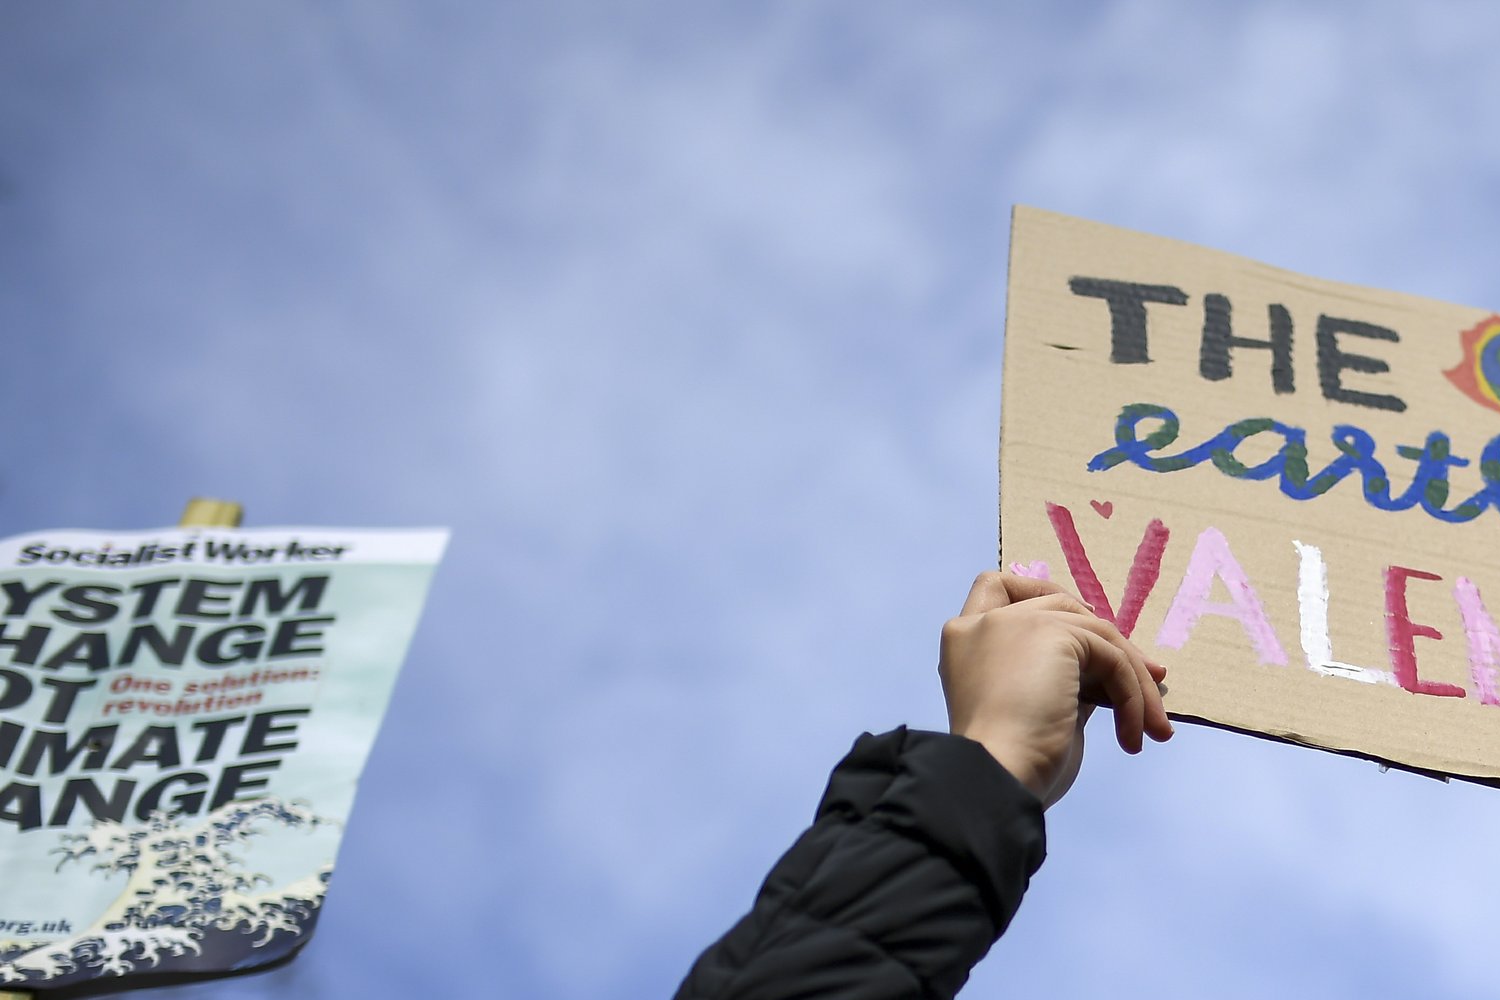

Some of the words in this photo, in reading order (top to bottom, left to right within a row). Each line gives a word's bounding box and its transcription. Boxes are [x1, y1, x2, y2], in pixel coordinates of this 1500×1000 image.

[1067, 275, 1408, 413] THE
[17, 539, 197, 567] Socialist
[205, 539, 348, 562] Worker
[110, 674, 172, 694] One
[184, 666, 321, 695] solution:
[102, 691, 264, 716] revolution
